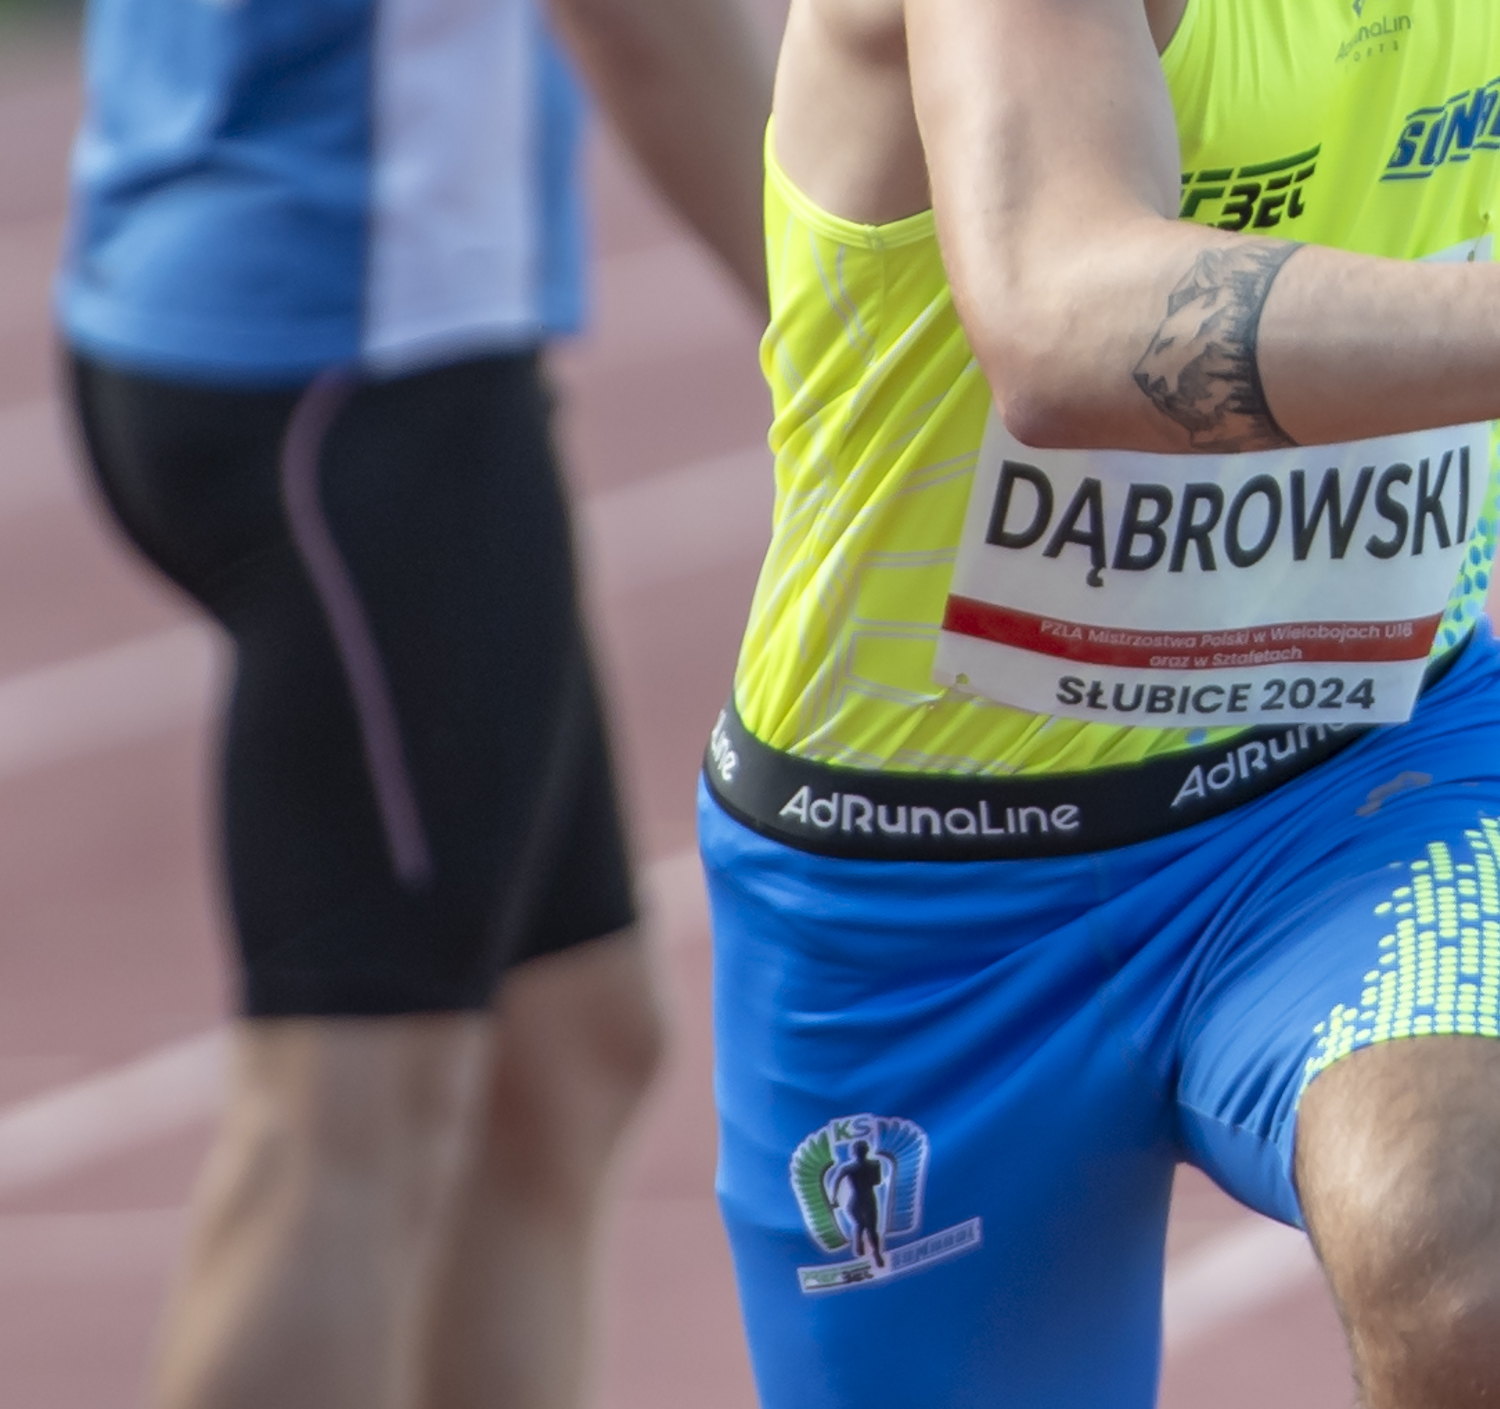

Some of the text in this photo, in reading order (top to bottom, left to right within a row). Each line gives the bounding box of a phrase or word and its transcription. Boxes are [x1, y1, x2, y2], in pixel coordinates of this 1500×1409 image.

[985, 446, 1473, 589] DĄBROWSKI
[1040, 619, 1083, 641] PZLA
[1087, 628, 1197, 649] Mistrzostwa
[1201, 629, 1250, 647] Polski
[1270, 624, 1380, 644] Wielobojach
[1149, 655, 1189, 669] oraz
[1211, 646, 1303, 667] Sztafetach
[1055, 675, 1376, 715] SŁUBICE 2024
[779, 785, 1081, 837] AdRunaLine
[833, 1117, 872, 1140] KS
